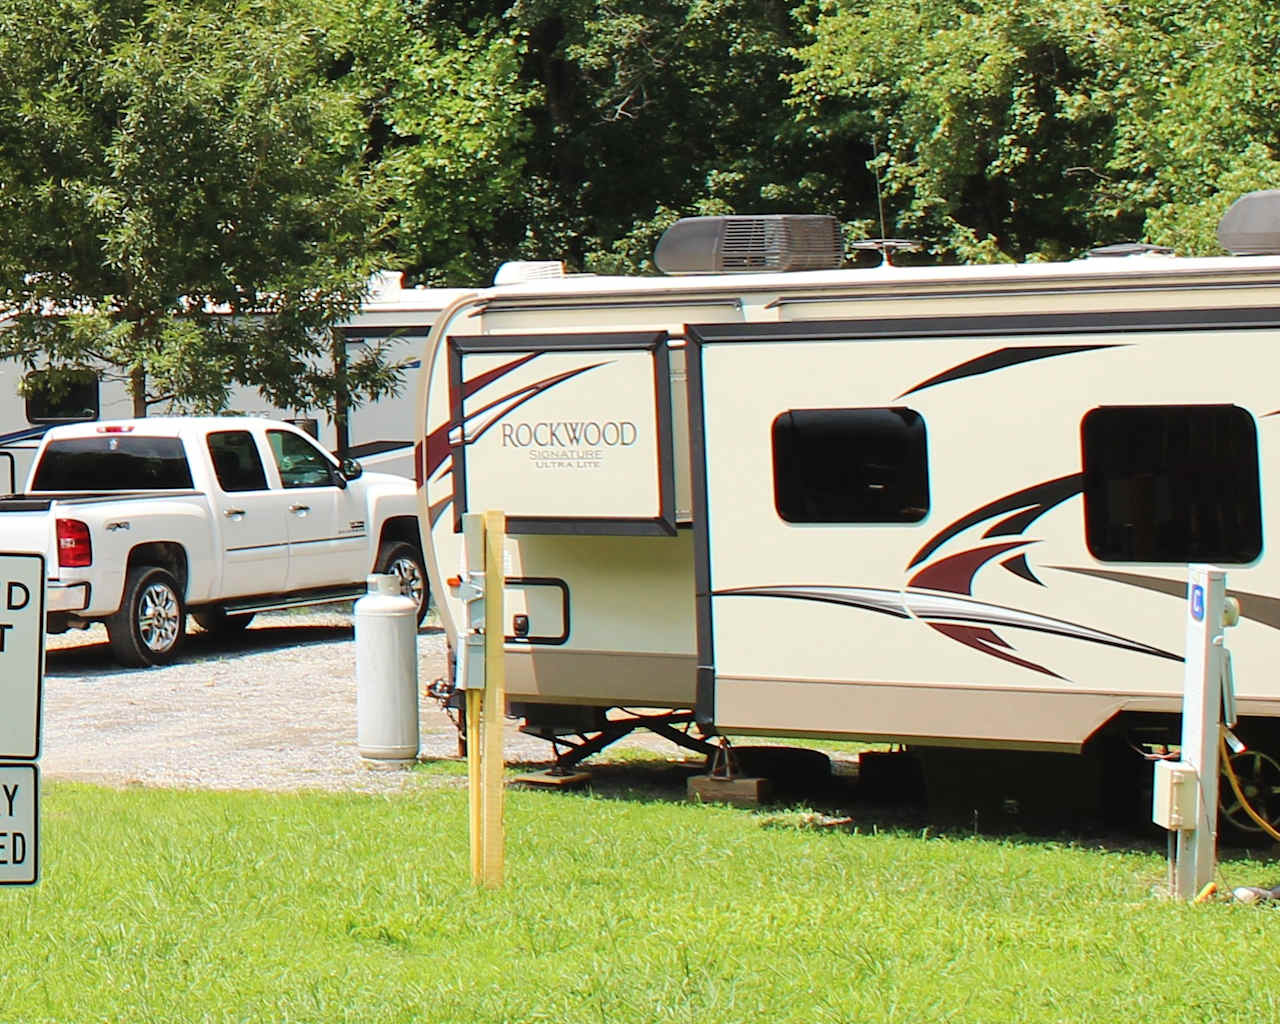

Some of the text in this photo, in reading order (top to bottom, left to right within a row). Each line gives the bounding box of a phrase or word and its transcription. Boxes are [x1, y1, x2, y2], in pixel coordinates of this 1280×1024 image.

[501, 421, 637, 447] ROCKWOOD
[528, 449, 604, 460] SIGNATURE
[536, 461, 602, 469] ULTRA LITE
